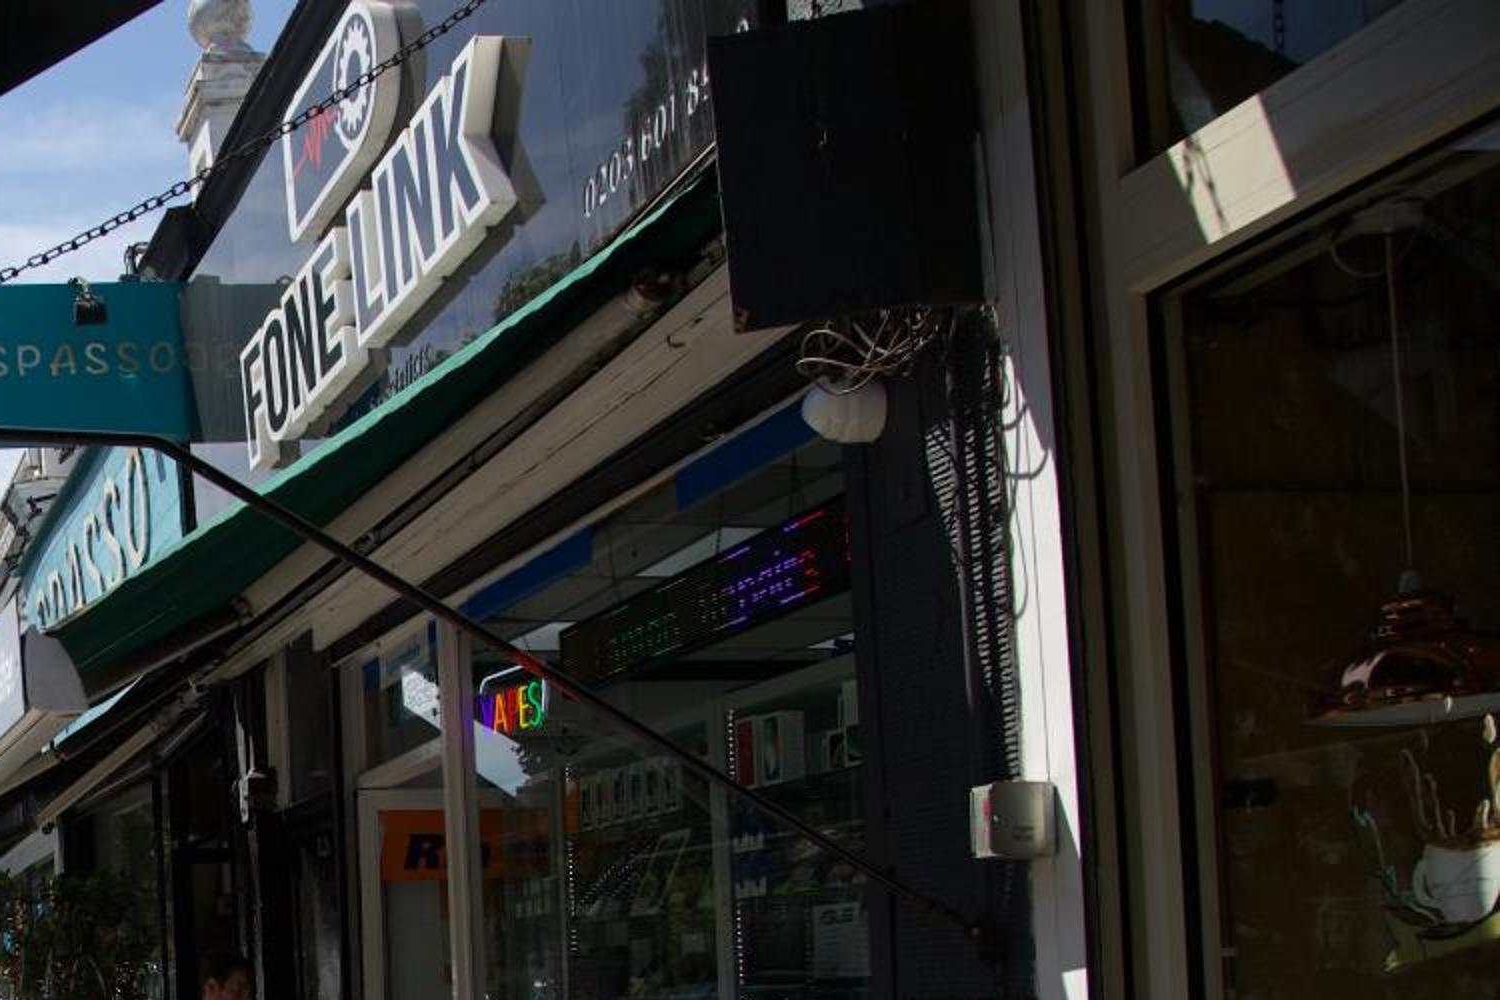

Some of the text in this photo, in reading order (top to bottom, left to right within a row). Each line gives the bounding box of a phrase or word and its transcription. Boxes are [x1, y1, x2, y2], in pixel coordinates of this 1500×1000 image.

[240, 40, 490, 468] FONE LINK
[476, 679, 542, 735] VAPES
